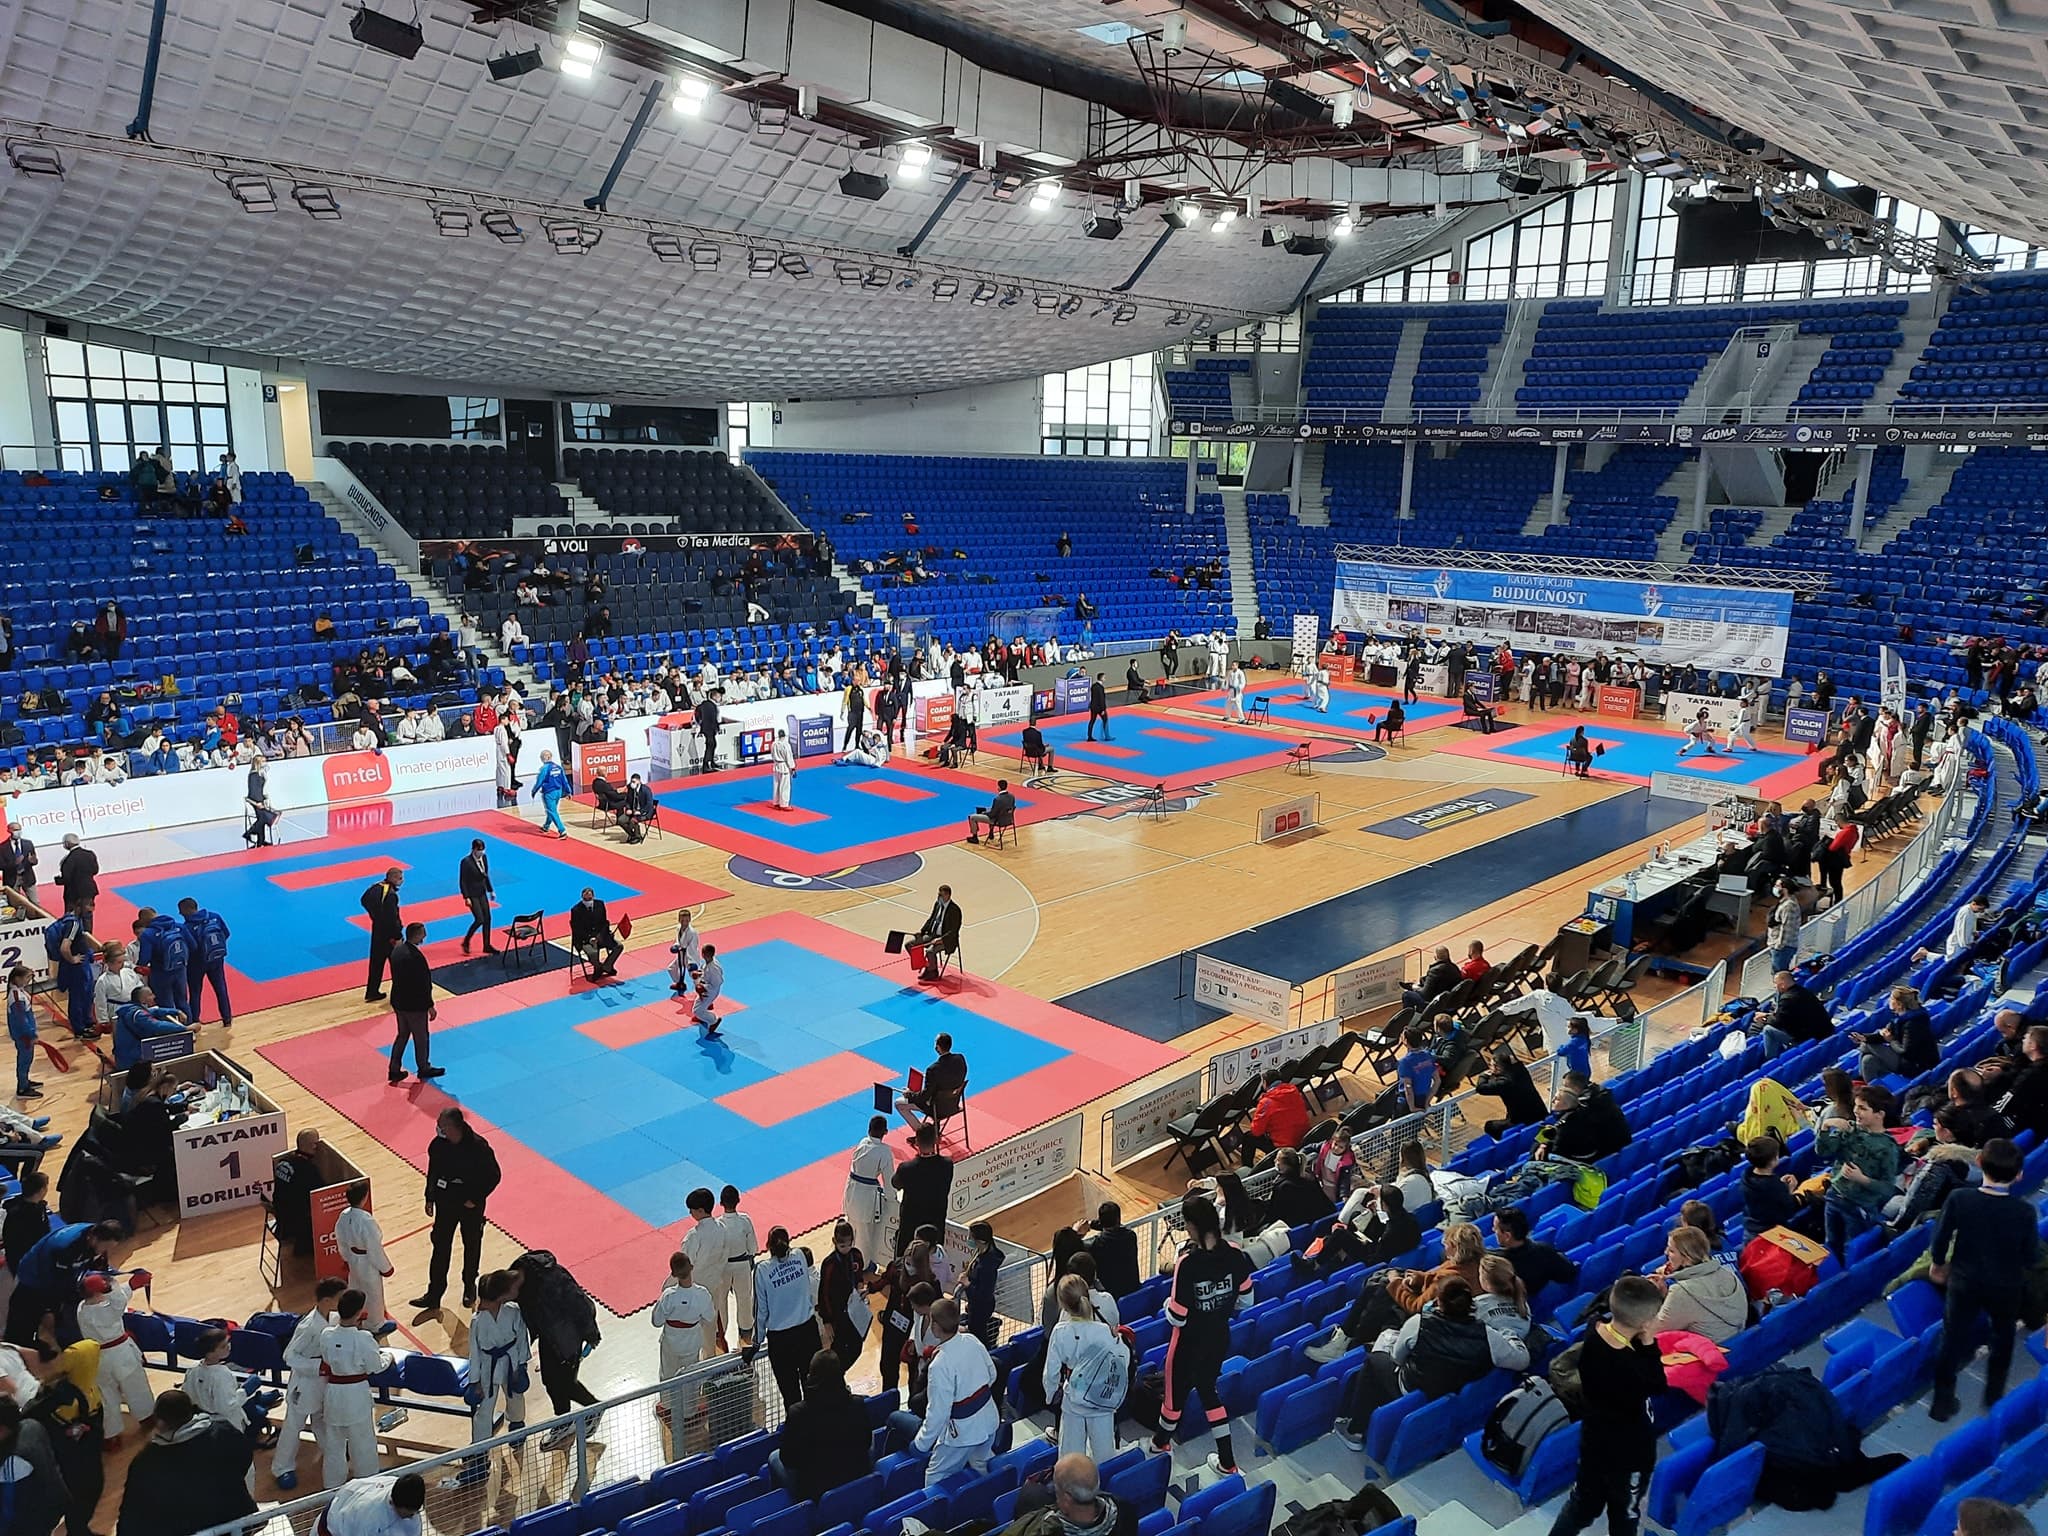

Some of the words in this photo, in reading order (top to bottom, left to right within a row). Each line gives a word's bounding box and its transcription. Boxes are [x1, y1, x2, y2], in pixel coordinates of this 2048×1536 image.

[265, 386, 275, 398] 9
[1227, 424, 1255, 435] AROMA
[1702, 428, 1737, 440] AROMA
[1813, 430, 1833, 439] NLB
[1903, 431, 1918, 439] Tea
[1921, 431, 1957, 439] Medica
[560, 540, 588, 552] VOLI
[690, 537, 709, 547] Tea
[712, 535, 750, 547] Medica
[1548, 578, 1573, 587] KLUB
[1003, 698, 1011, 710] 4
[1603, 695, 1630, 704] COACH
[1687, 697, 1723, 707] TATAMI
[931, 705, 952, 714] COACH
[1604, 703, 1627, 713] TRENER
[1791, 718, 1822, 728] COACH
[803, 727, 829, 737] COACH
[1792, 728, 1818, 737] TRENER
[396, 762, 432, 775] Imate
[435, 752, 489, 772] prijatelje!
[586, 754, 621, 765] COACH
[16, 810, 65, 826] Imate
[71, 798, 145, 824] prijatelje!
[1, 946, 21, 968] 2
[186, 1123, 277, 1149] TATAMI
[985, 1148, 1018, 1166] KARATE
[1019, 1140, 1038, 1152] KUP
[1016, 1137, 1064, 1162] PODGORICE
[220, 1151, 241, 1179] 1
[187, 1180, 274, 1208] BORILIŠT
[1195, 1279, 1231, 1296] SUPER
